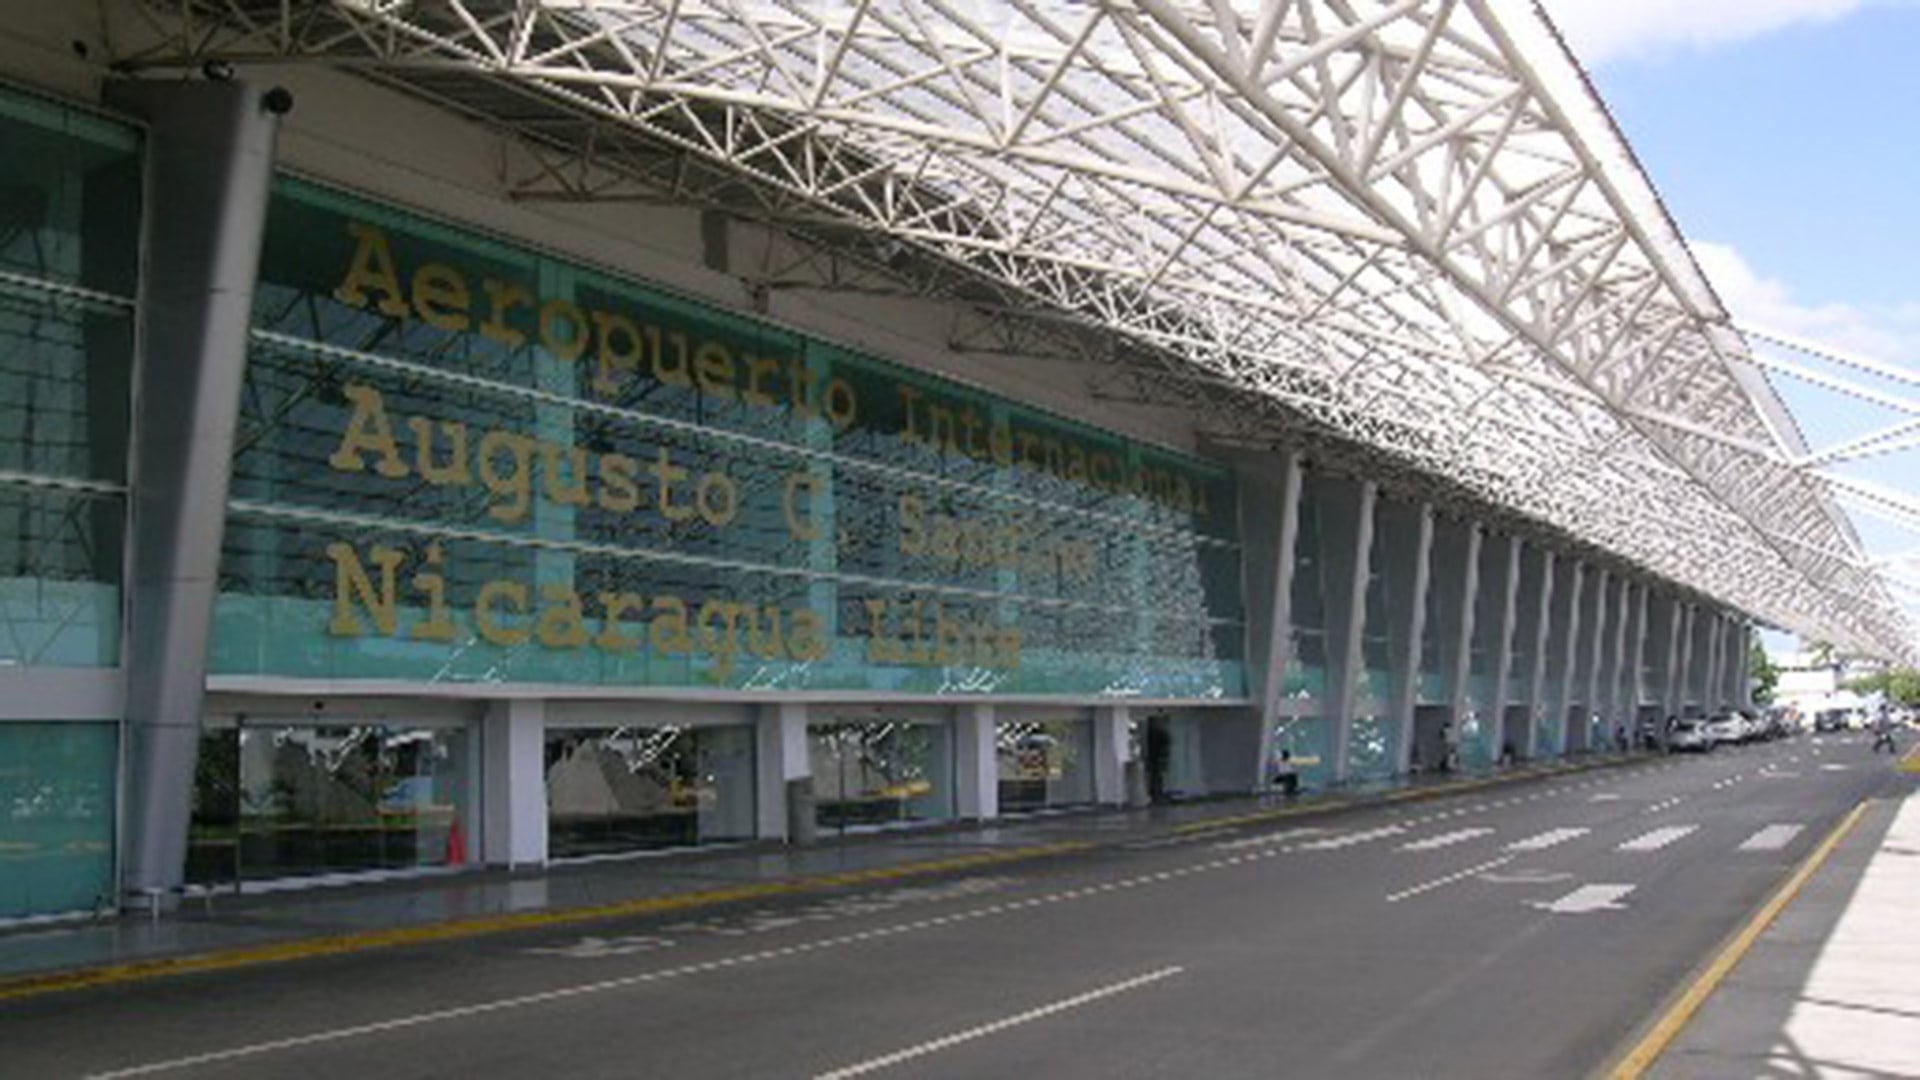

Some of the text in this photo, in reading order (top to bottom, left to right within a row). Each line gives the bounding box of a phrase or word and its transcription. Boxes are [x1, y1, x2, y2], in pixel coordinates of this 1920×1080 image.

[334, 221, 1208, 514] Aeropuerto Internacional
[330, 383, 737, 525] Augusto
[326, 541, 829, 683] Nicaragua
